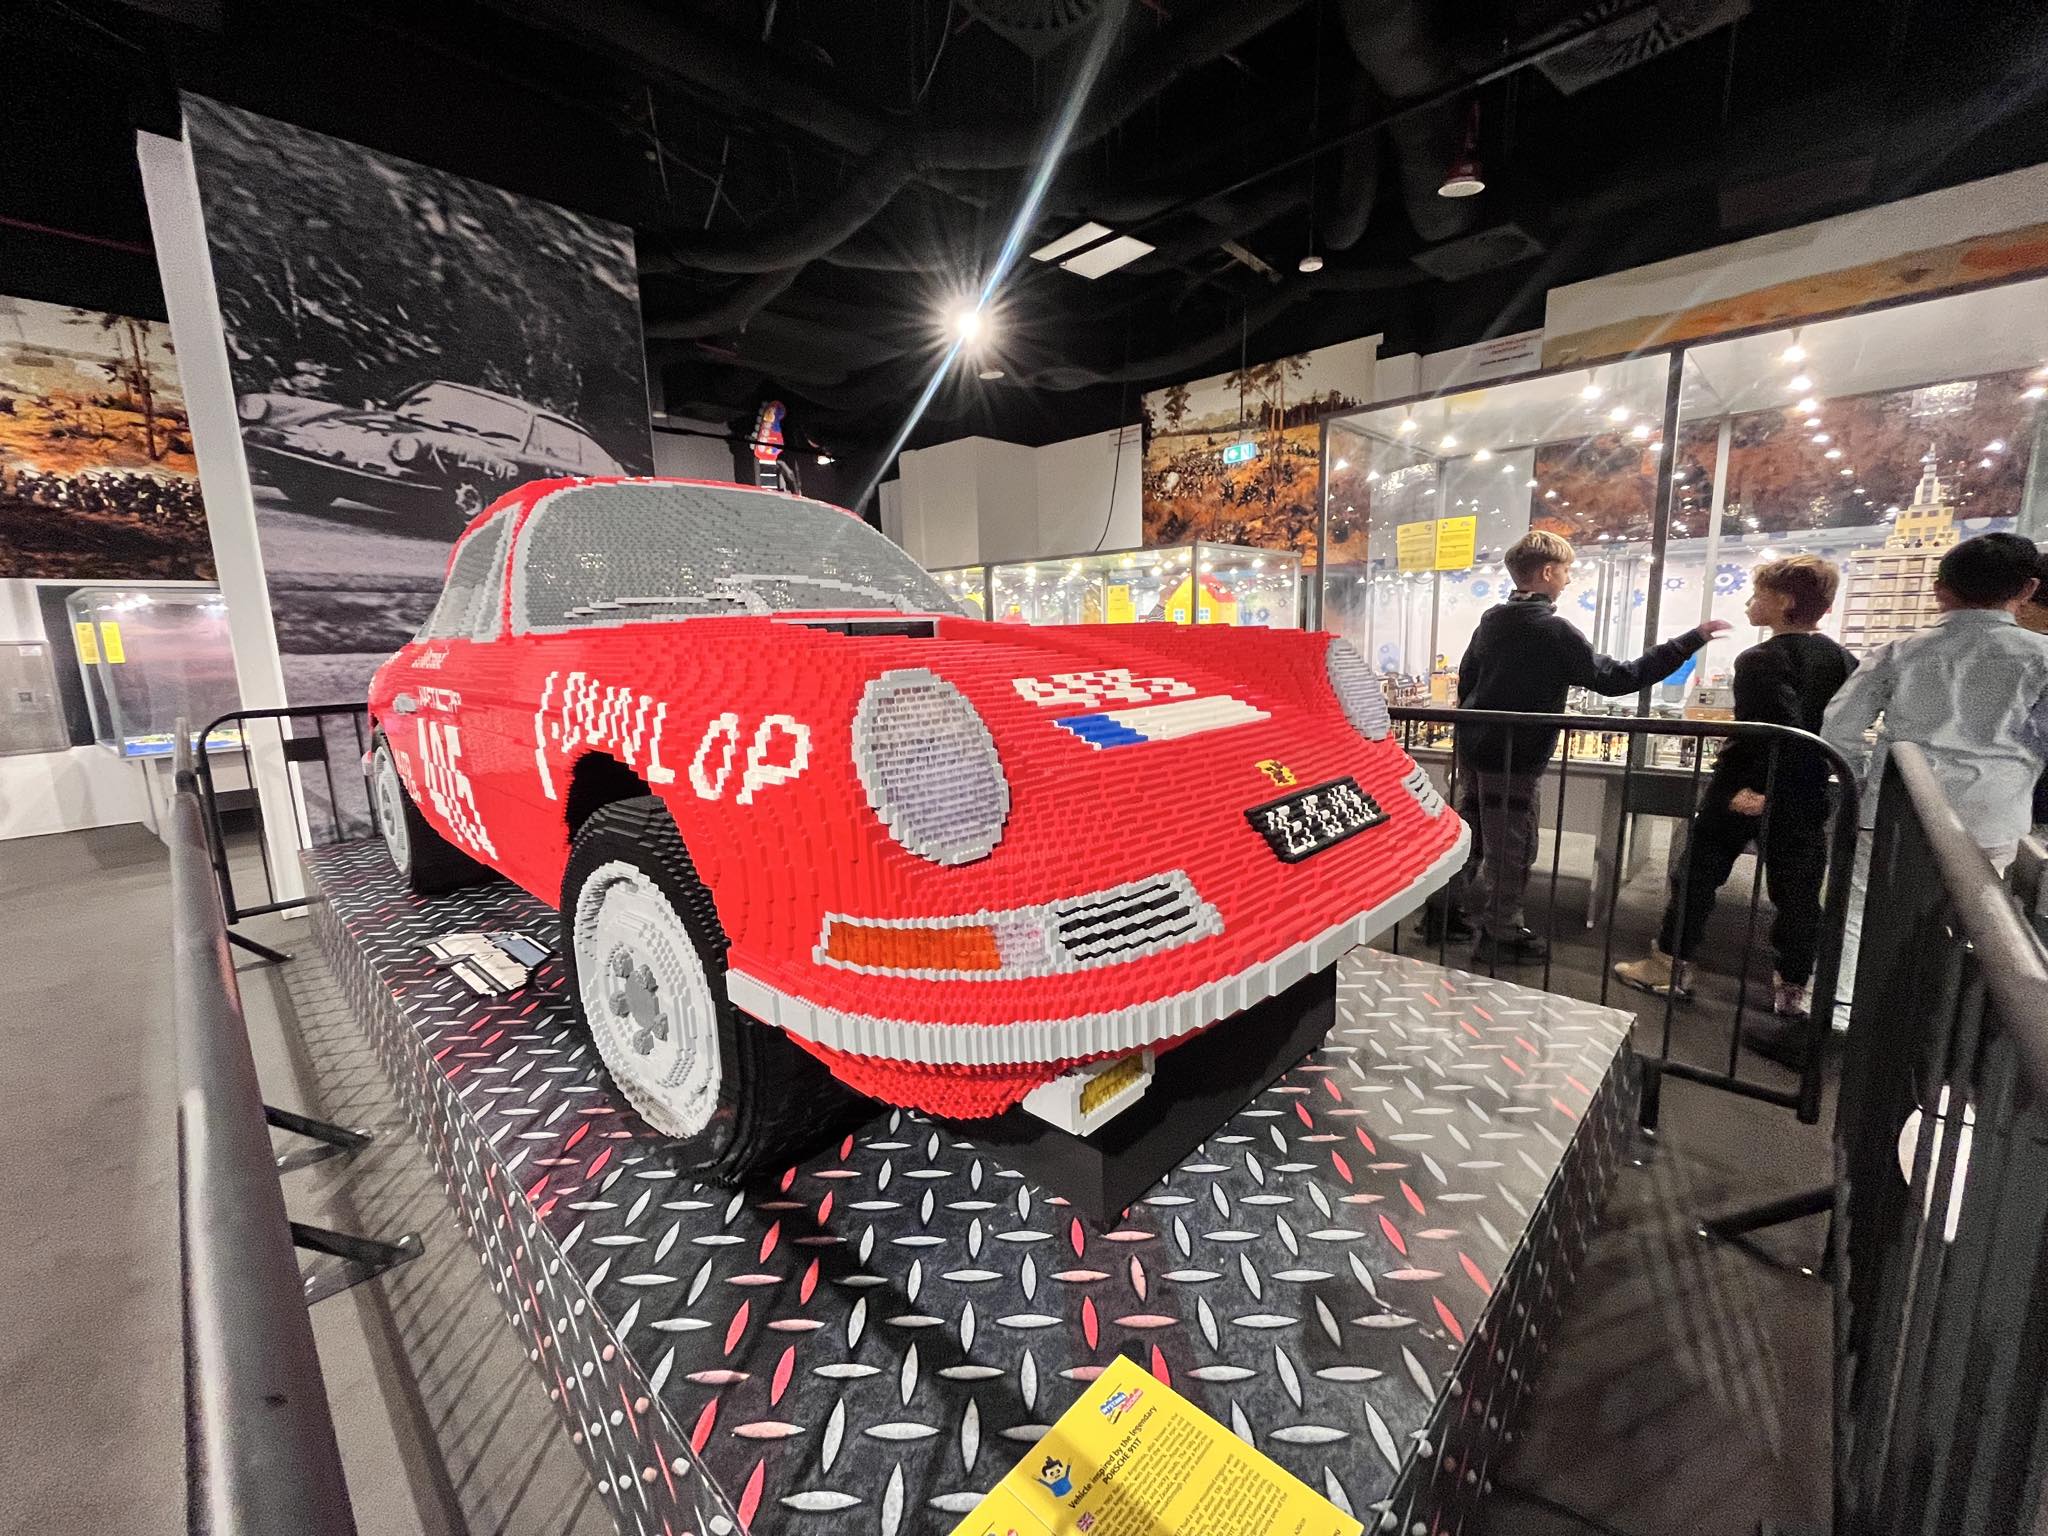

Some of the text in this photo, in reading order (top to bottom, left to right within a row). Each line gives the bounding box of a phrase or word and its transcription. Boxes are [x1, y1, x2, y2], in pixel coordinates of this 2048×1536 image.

[1068, 1481, 1093, 1509] Vehicle
[1089, 1454, 1117, 1485] inspired
[1112, 1445, 1124, 1457] by
[1119, 1434, 1132, 1448] the
[1129, 1404, 1158, 1437] legendary
[1102, 1437, 1142, 1485] PORSCHE 911T
